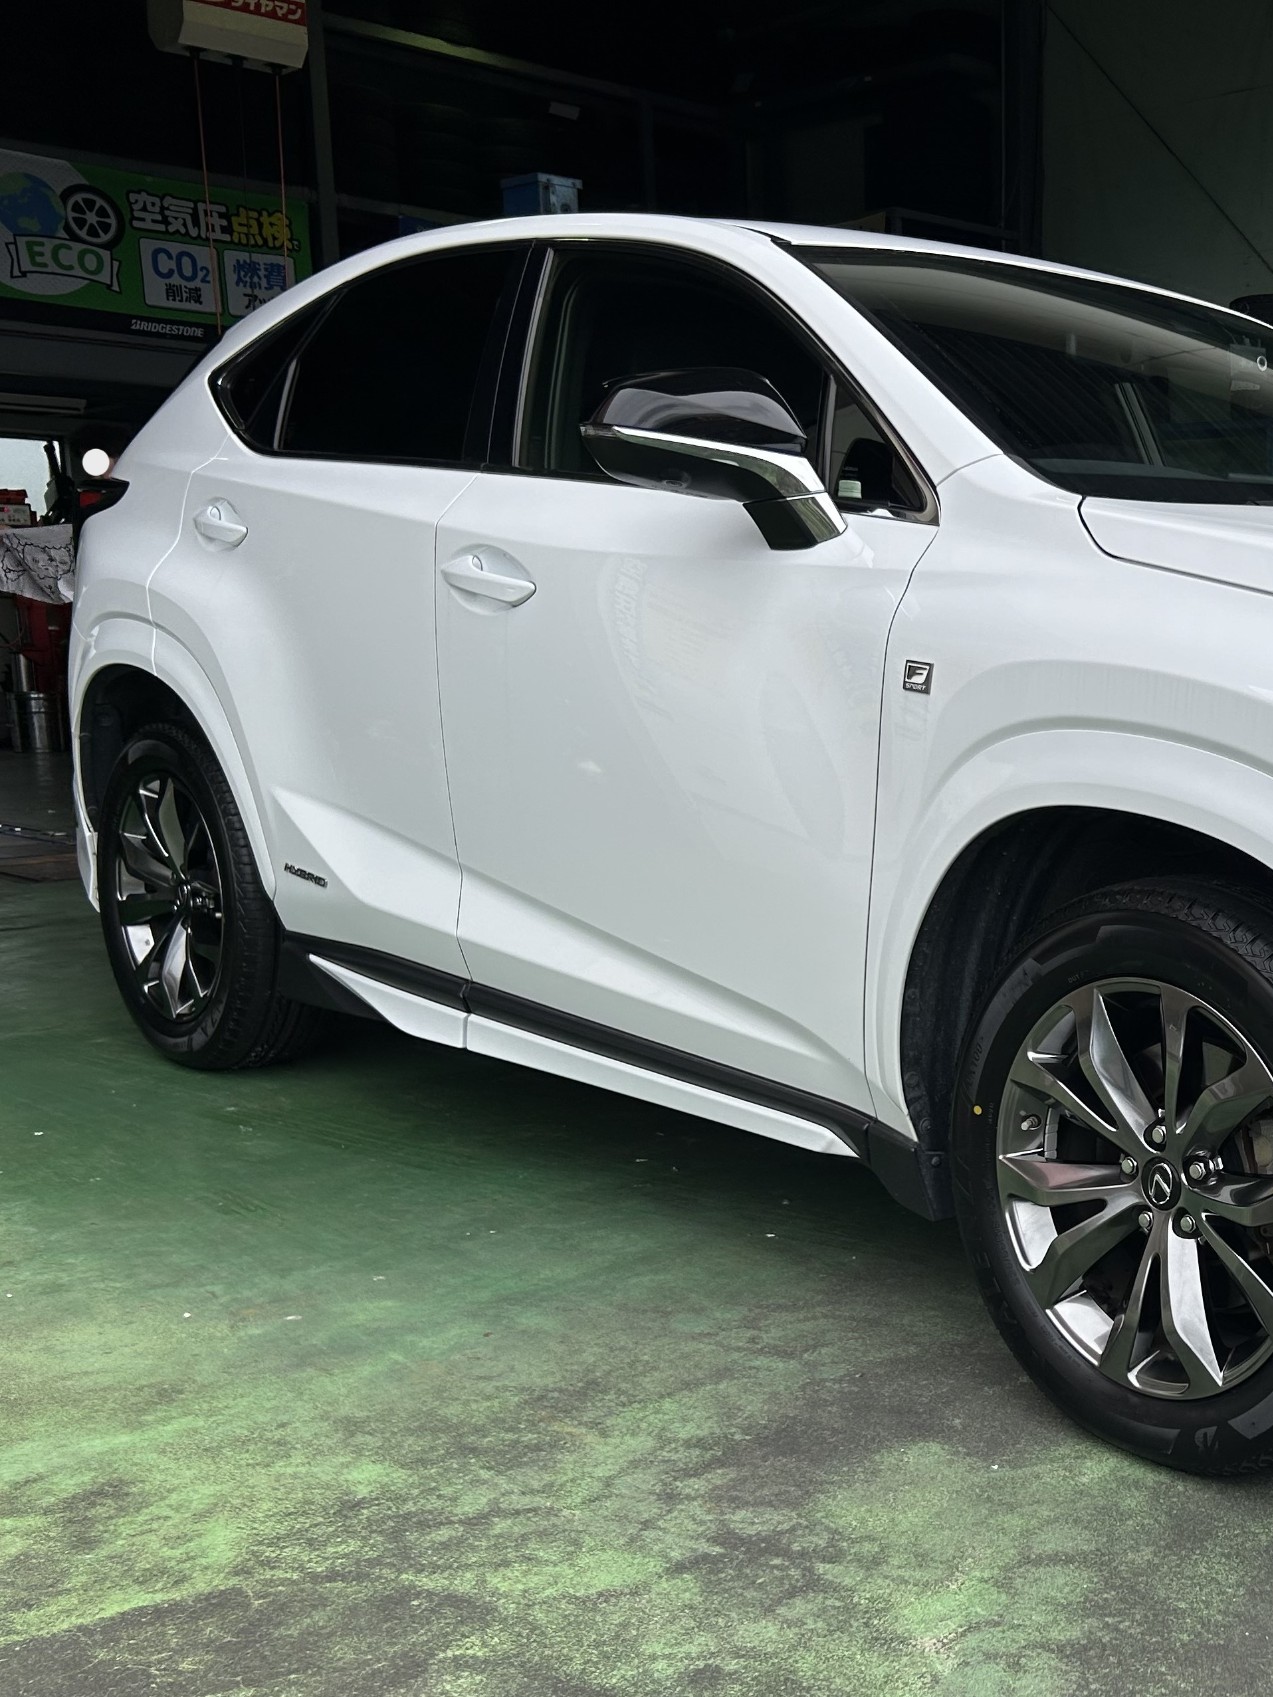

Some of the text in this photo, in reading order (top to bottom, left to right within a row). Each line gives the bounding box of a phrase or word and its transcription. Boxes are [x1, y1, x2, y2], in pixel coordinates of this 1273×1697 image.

[25, 240, 104, 276] ECO
[233, 258, 287, 291] 燃費
[165, 282, 203, 306] 削減
[130, 318, 205, 338] BRIDGESTONE
